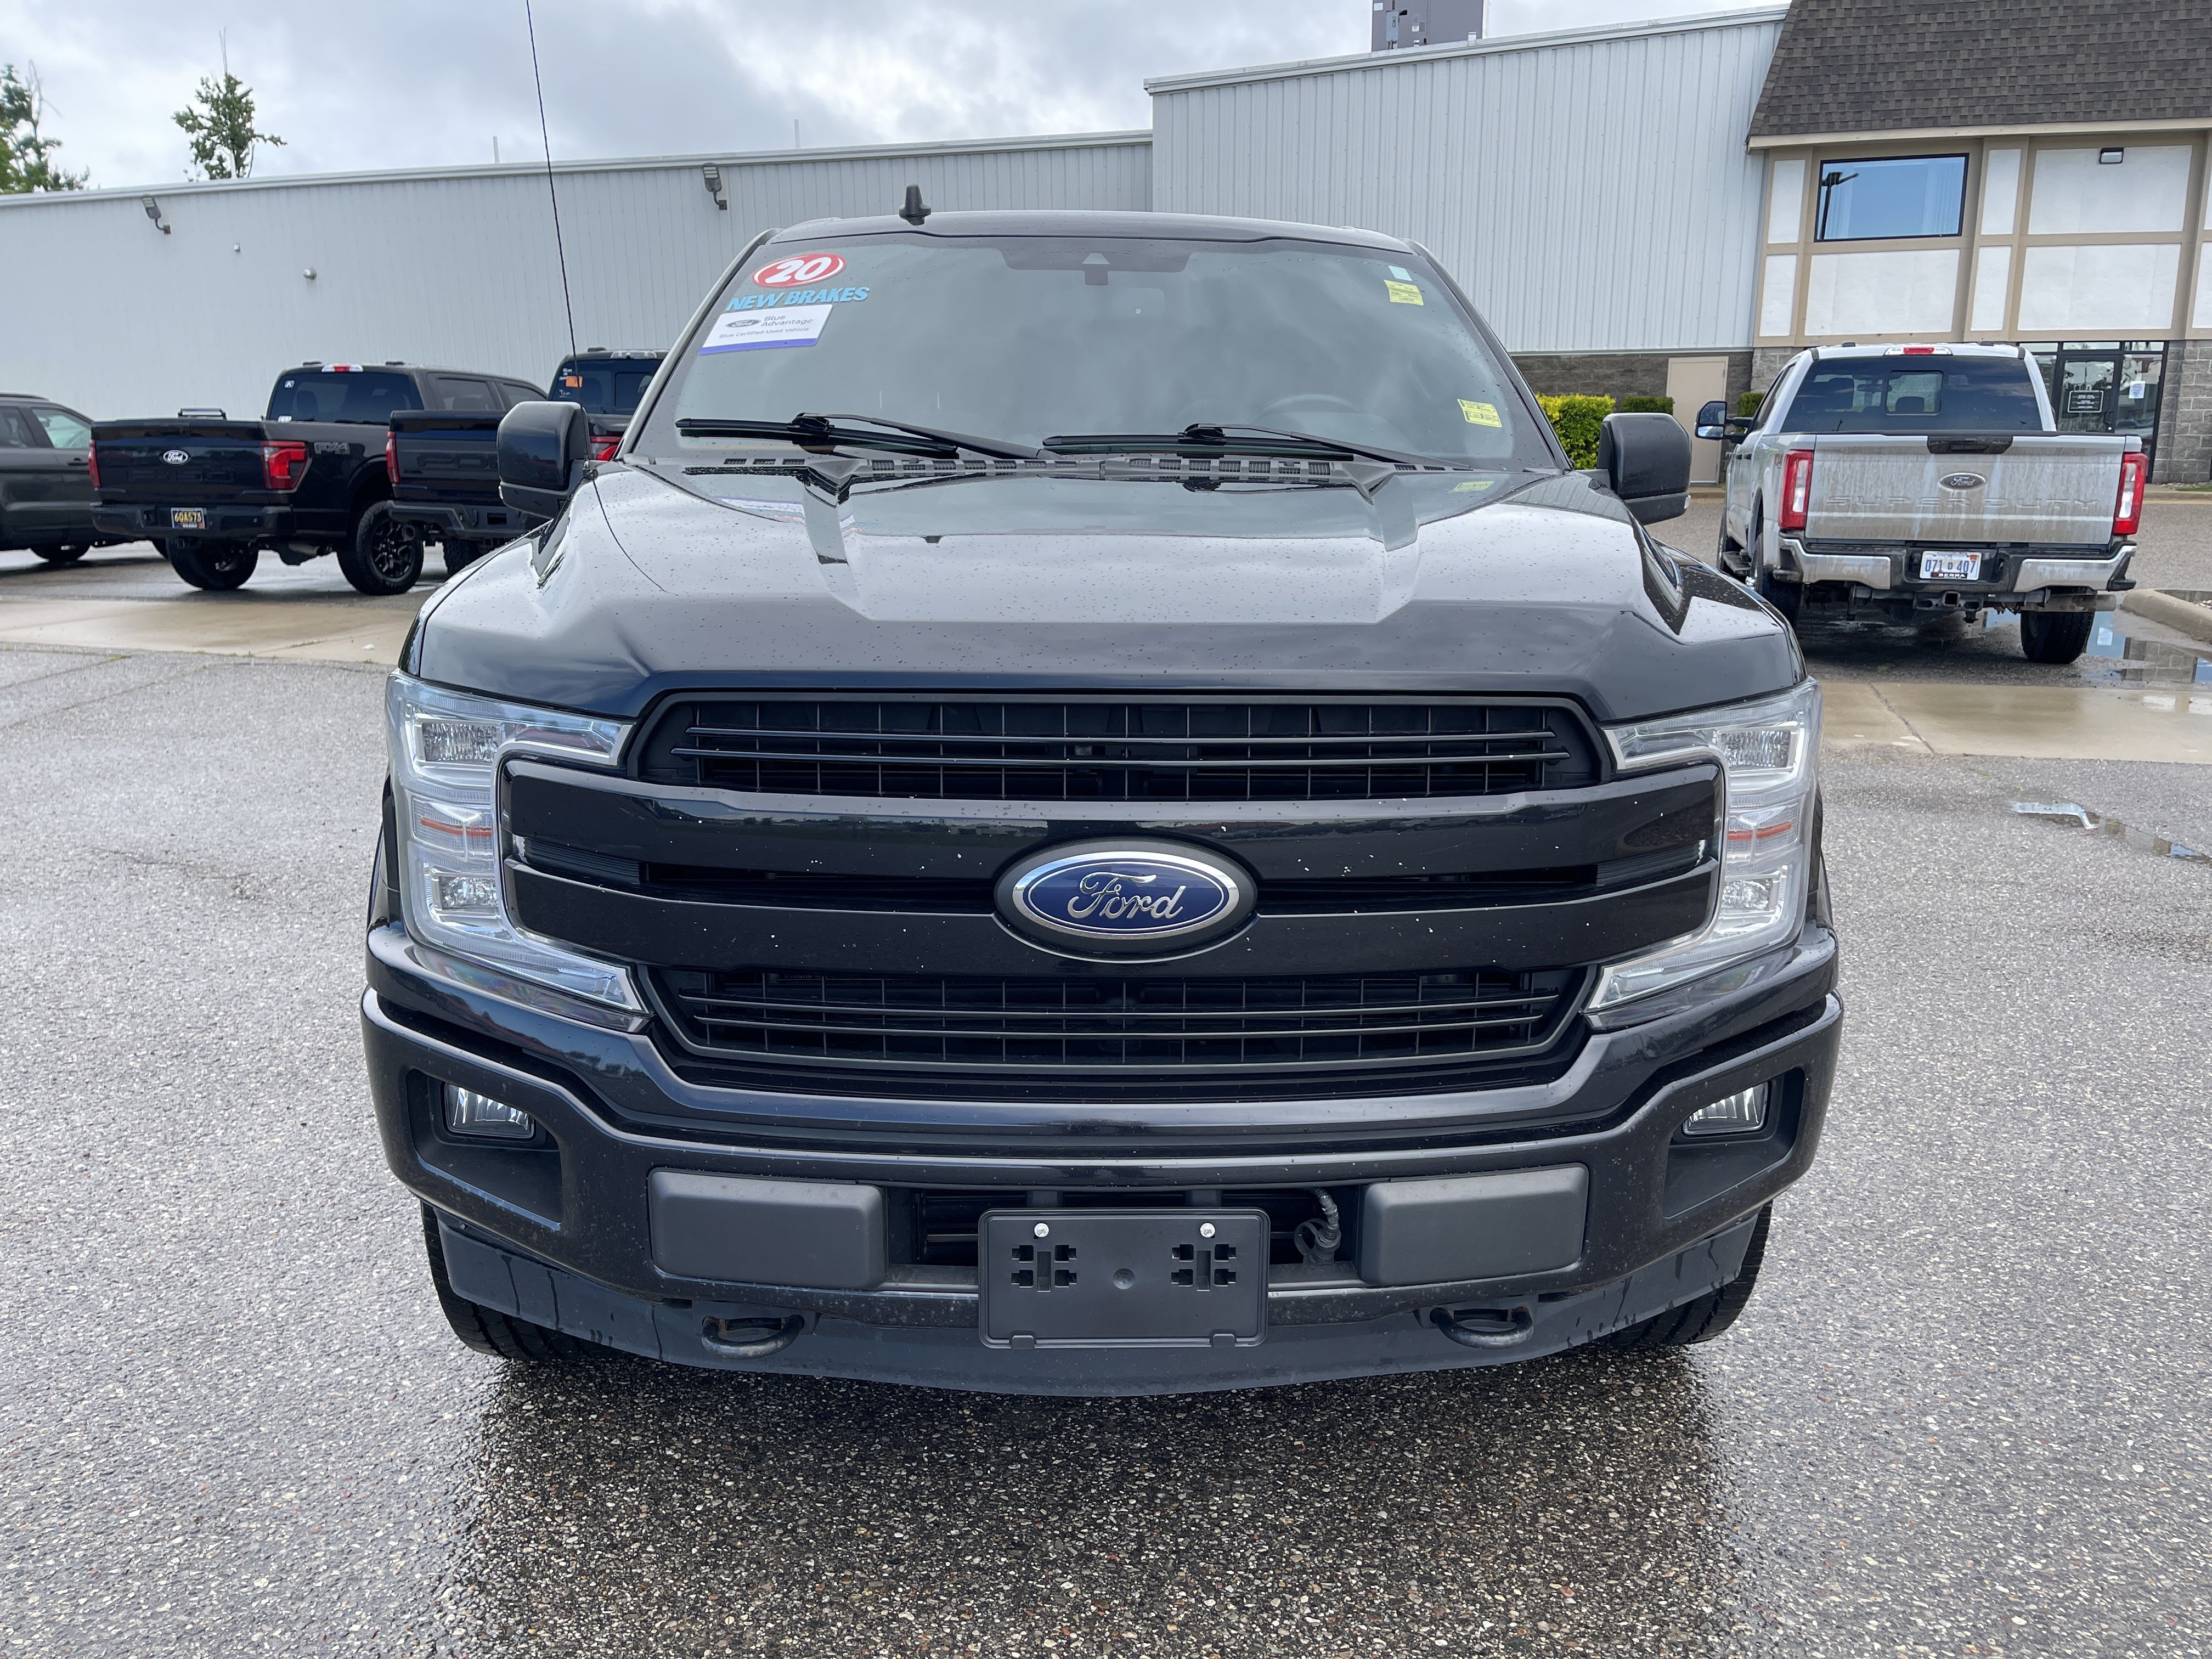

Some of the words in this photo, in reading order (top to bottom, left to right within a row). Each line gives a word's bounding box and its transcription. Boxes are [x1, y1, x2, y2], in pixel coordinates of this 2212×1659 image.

[765, 256, 832, 284] 20
[725, 292, 786, 312] NEW
[784, 286, 871, 306] BRAKES
[761, 319, 813, 327] Advantage
[1950, 476, 1976, 486] Ford
[1826, 495, 1971, 507] SUPER
[1984, 496, 2098, 509] DUTY
[1925, 560, 1943, 572] 071
[1957, 560, 1976, 573] 407
[1066, 871, 1187, 919] Ford
